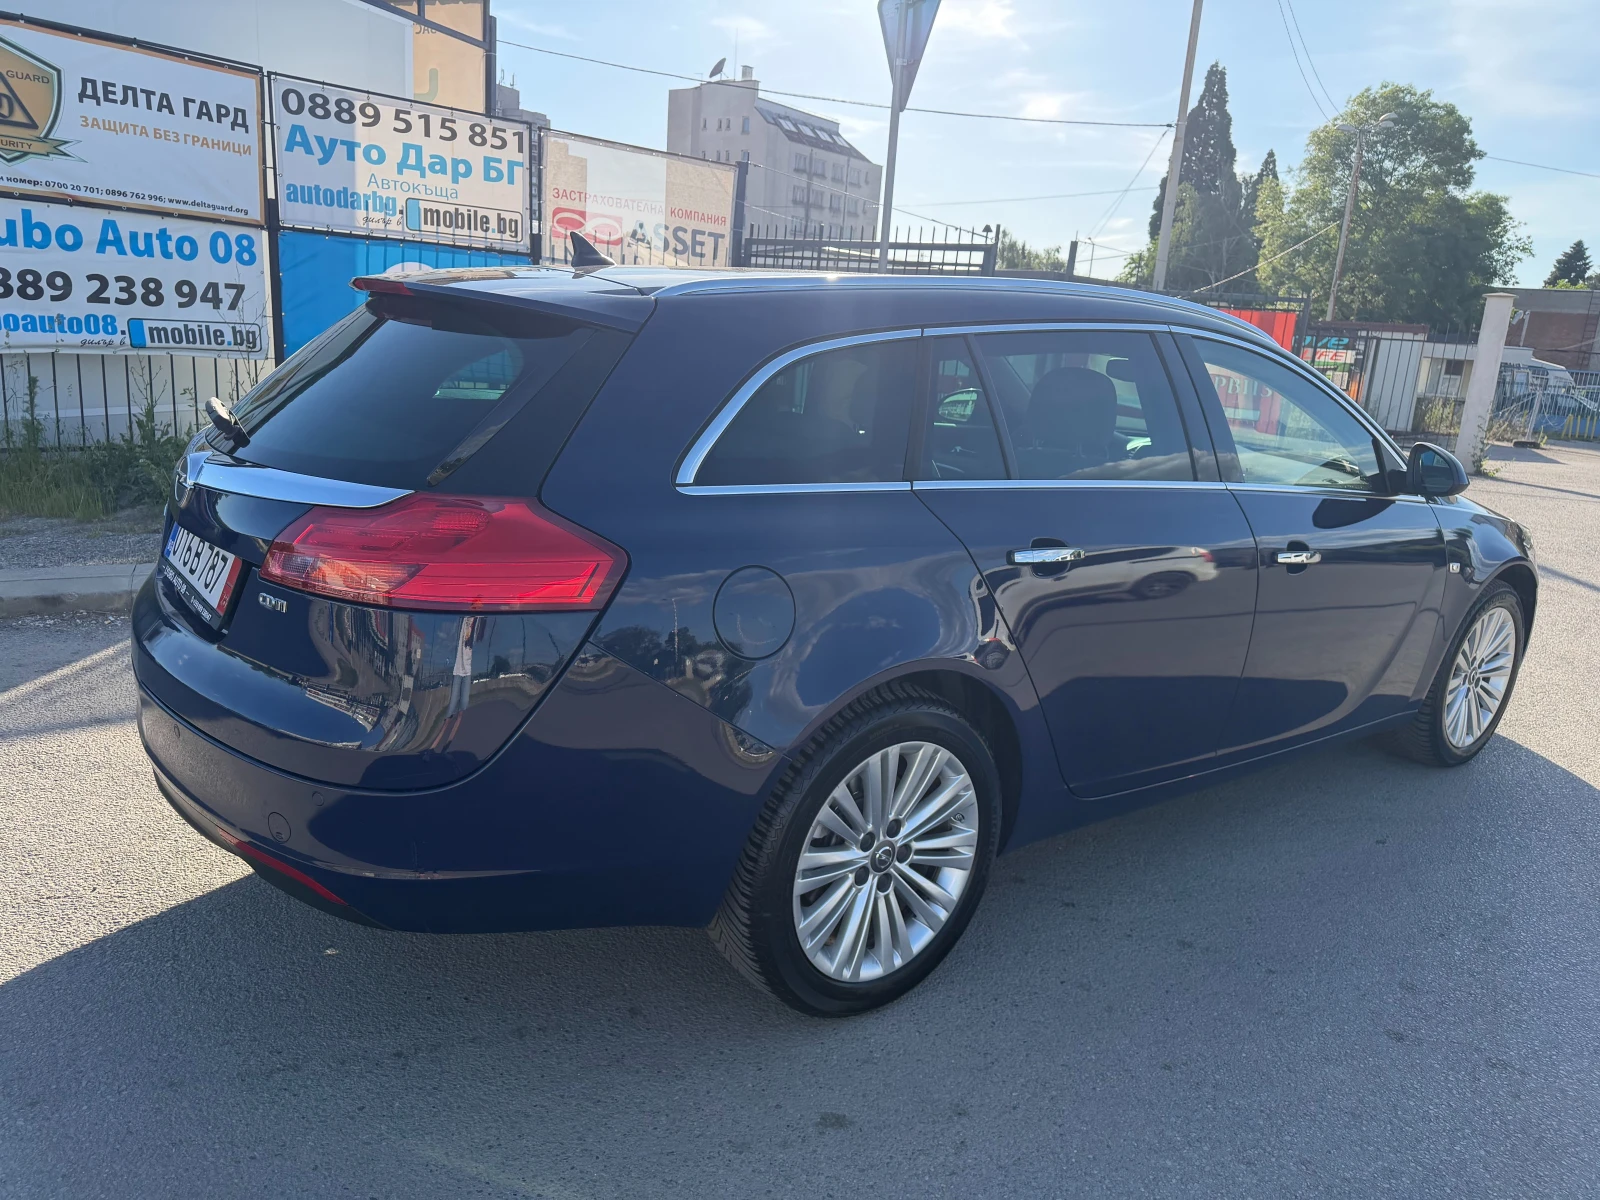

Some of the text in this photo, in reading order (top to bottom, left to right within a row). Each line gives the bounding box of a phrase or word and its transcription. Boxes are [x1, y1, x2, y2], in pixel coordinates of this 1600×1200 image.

[6, 70, 50, 84] GUARD
[77, 76, 250, 134] ДЕЛТА ГАРД
[281, 88, 524, 154] 0889 515 851
[79, 116, 252, 156] ЗАЩИТА БЕЗ ГРАНИЦИ
[284, 123, 524, 186] Ауто Дар БГ
[6, 176, 42, 187] номер:
[45, 180, 68, 190] 0700
[83, 186, 103, 196] 701;
[105, 189, 128, 197] 0896
[129, 191, 146, 200] 762
[147, 194, 166, 203] 996;
[167, 197, 249, 216] www.deltaguard.org
[367, 173, 459, 201] Автокъща
[552, 187, 727, 226] ЗАСТРАХОВАТЕЛНА КОМПАНИЯ
[95, 218, 199, 262] Auto
[209, 230, 257, 267] 08
[423, 206, 519, 239] mobile.bg
[627, 219, 726, 261] ASSET
[85, 273, 164, 307] 238
[174, 279, 246, 311] 947
[0, 313, 257, 350] oauto08. mobile.bg
